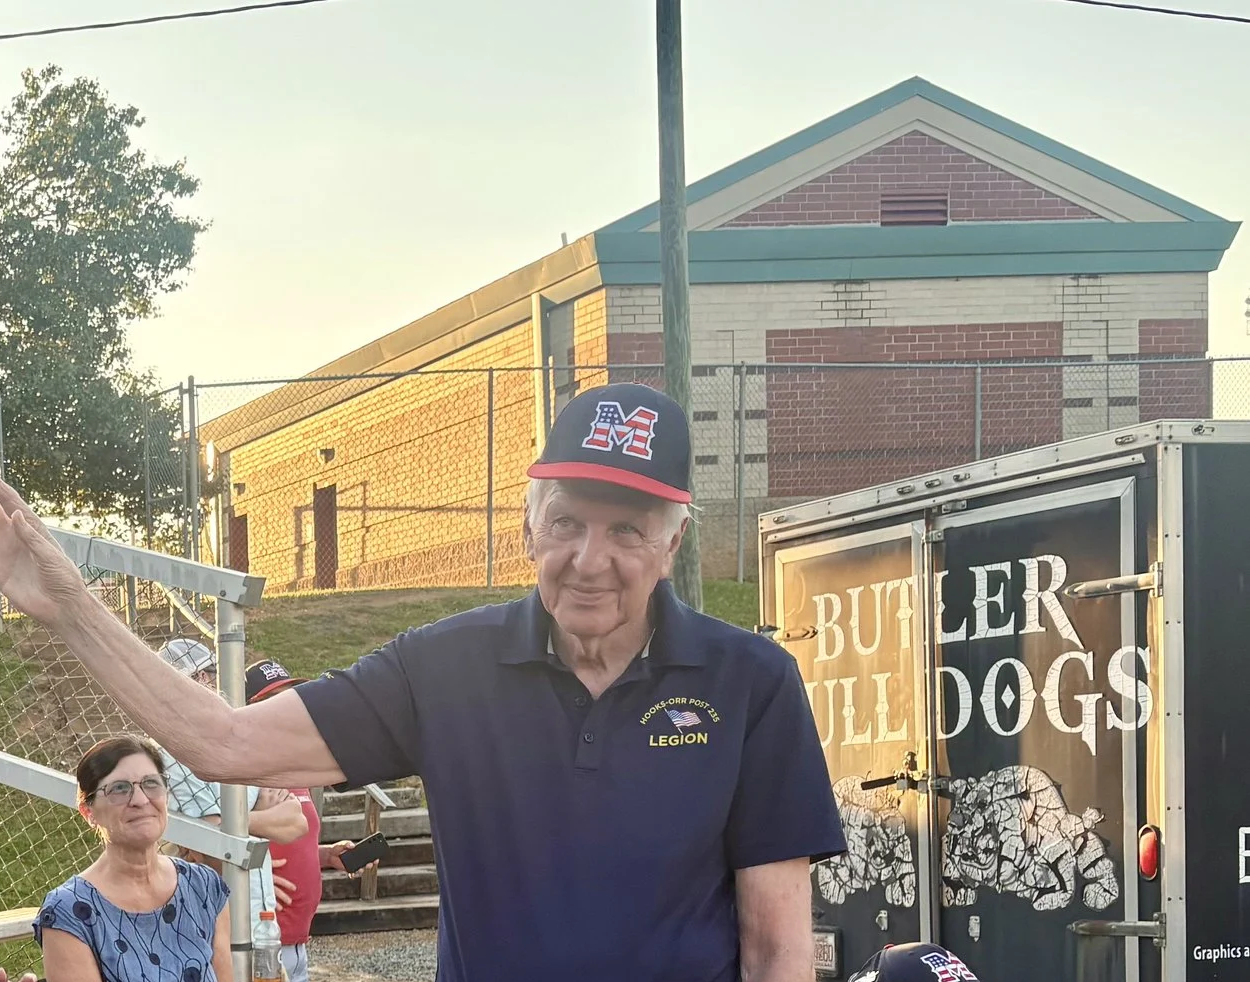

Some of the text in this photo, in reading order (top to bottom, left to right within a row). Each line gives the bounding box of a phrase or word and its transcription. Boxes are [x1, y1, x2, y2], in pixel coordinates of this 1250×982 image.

[582, 401, 659, 461] M
[812, 554, 1085, 663] BUTLER
[639, 697, 721, 725] HOOKS-ORR POST 235
[649, 732, 708, 747] LEGION
[1193, 945, 1241, 964] Graphics
